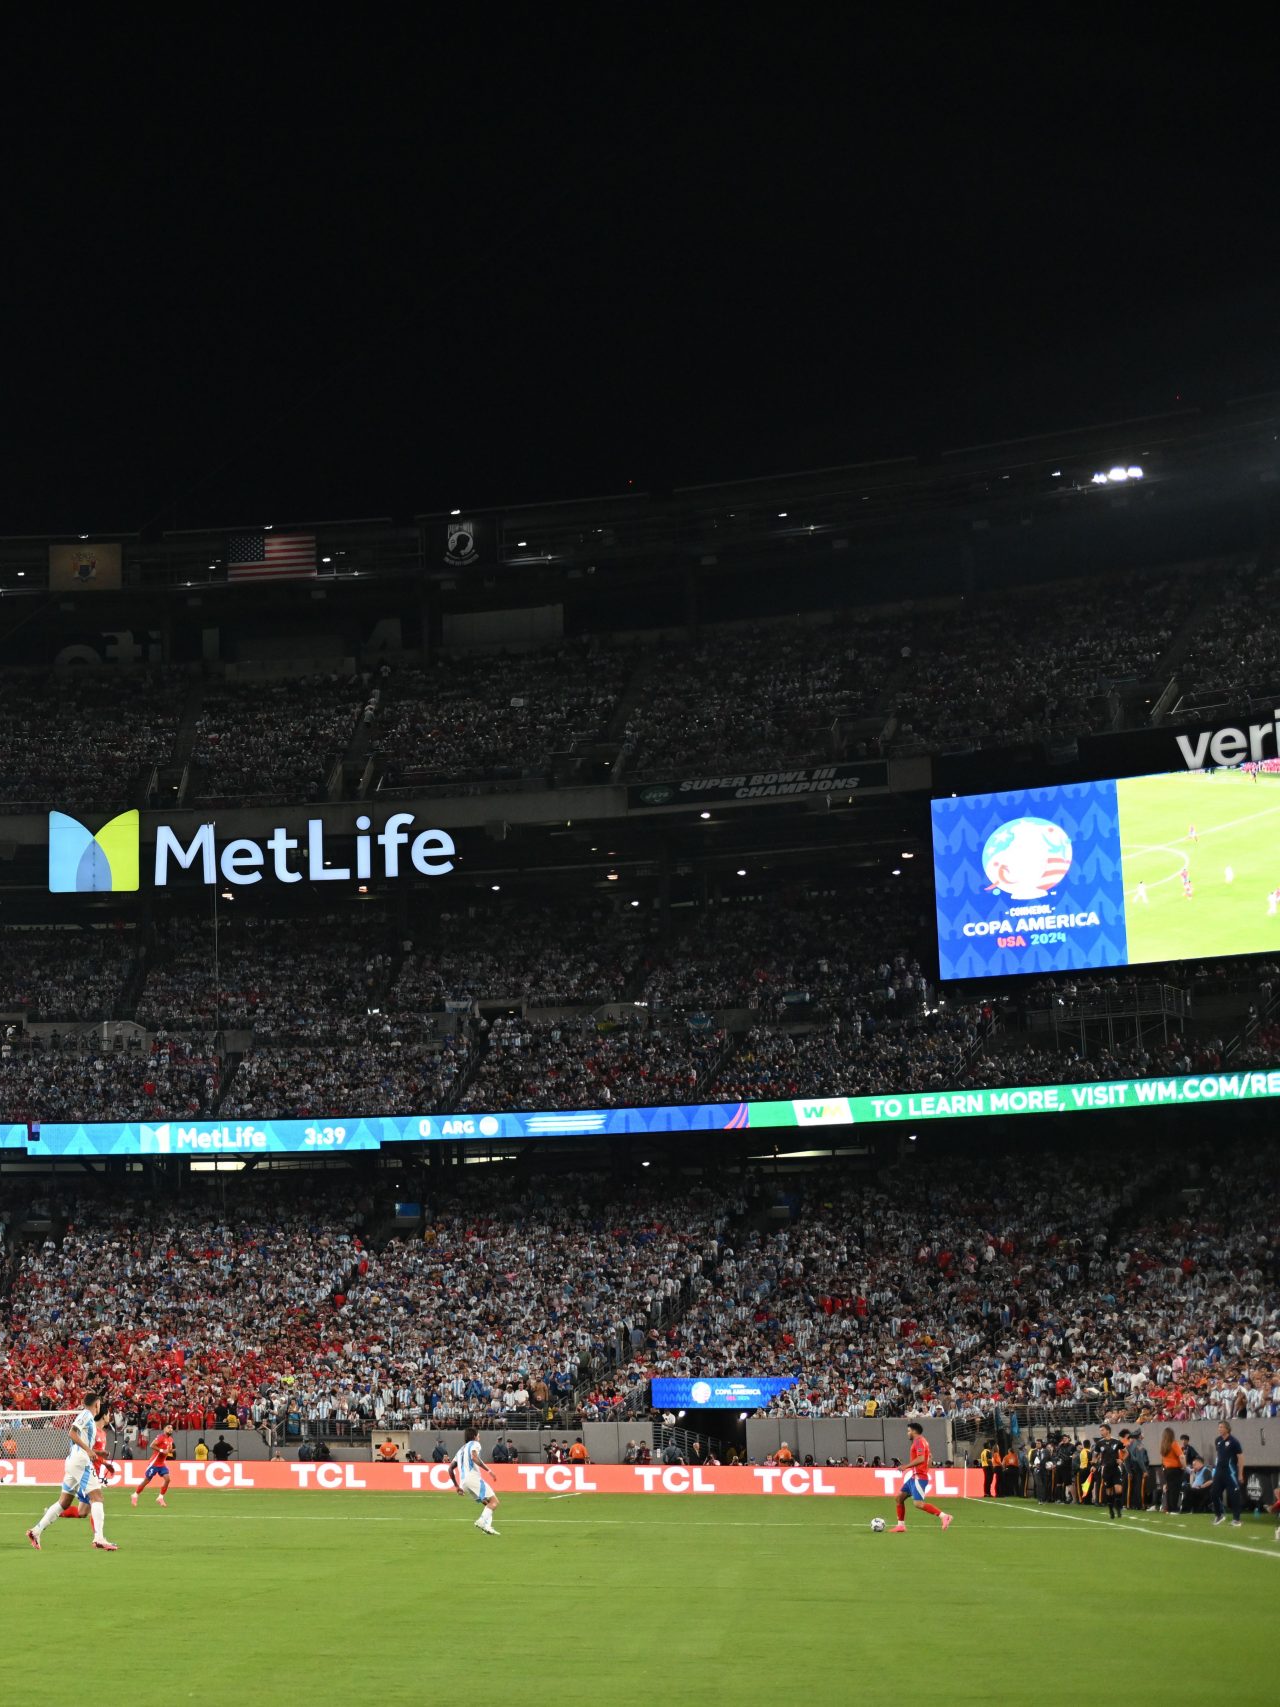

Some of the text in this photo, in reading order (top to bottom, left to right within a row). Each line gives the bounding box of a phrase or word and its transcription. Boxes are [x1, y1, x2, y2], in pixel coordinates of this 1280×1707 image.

[679, 768, 838, 792] SUPER BOWL III
[735, 777, 861, 799] CHAMPIONS
[154, 813, 456, 886] MetLife
[963, 912, 1100, 937] COPA AMERICA
[997, 932, 1067, 948] USA 2024
[871, 1099, 902, 1118] TO
[908, 1095, 983, 1116] LEARN
[991, 1088, 1065, 1112] MORE,
[1072, 1084, 1128, 1107] VISIT
[177, 1127, 267, 1149] MetLife
[304, 1127, 346, 1145] 3:39
[420, 1119, 475, 1137] 0 ARG
[180, 1462, 254, 1486] TCL
[290, 1464, 366, 1488] TCL
[518, 1466, 596, 1490] TCL
[634, 1467, 715, 1492] TCL
[754, 1468, 835, 1493] TCL
